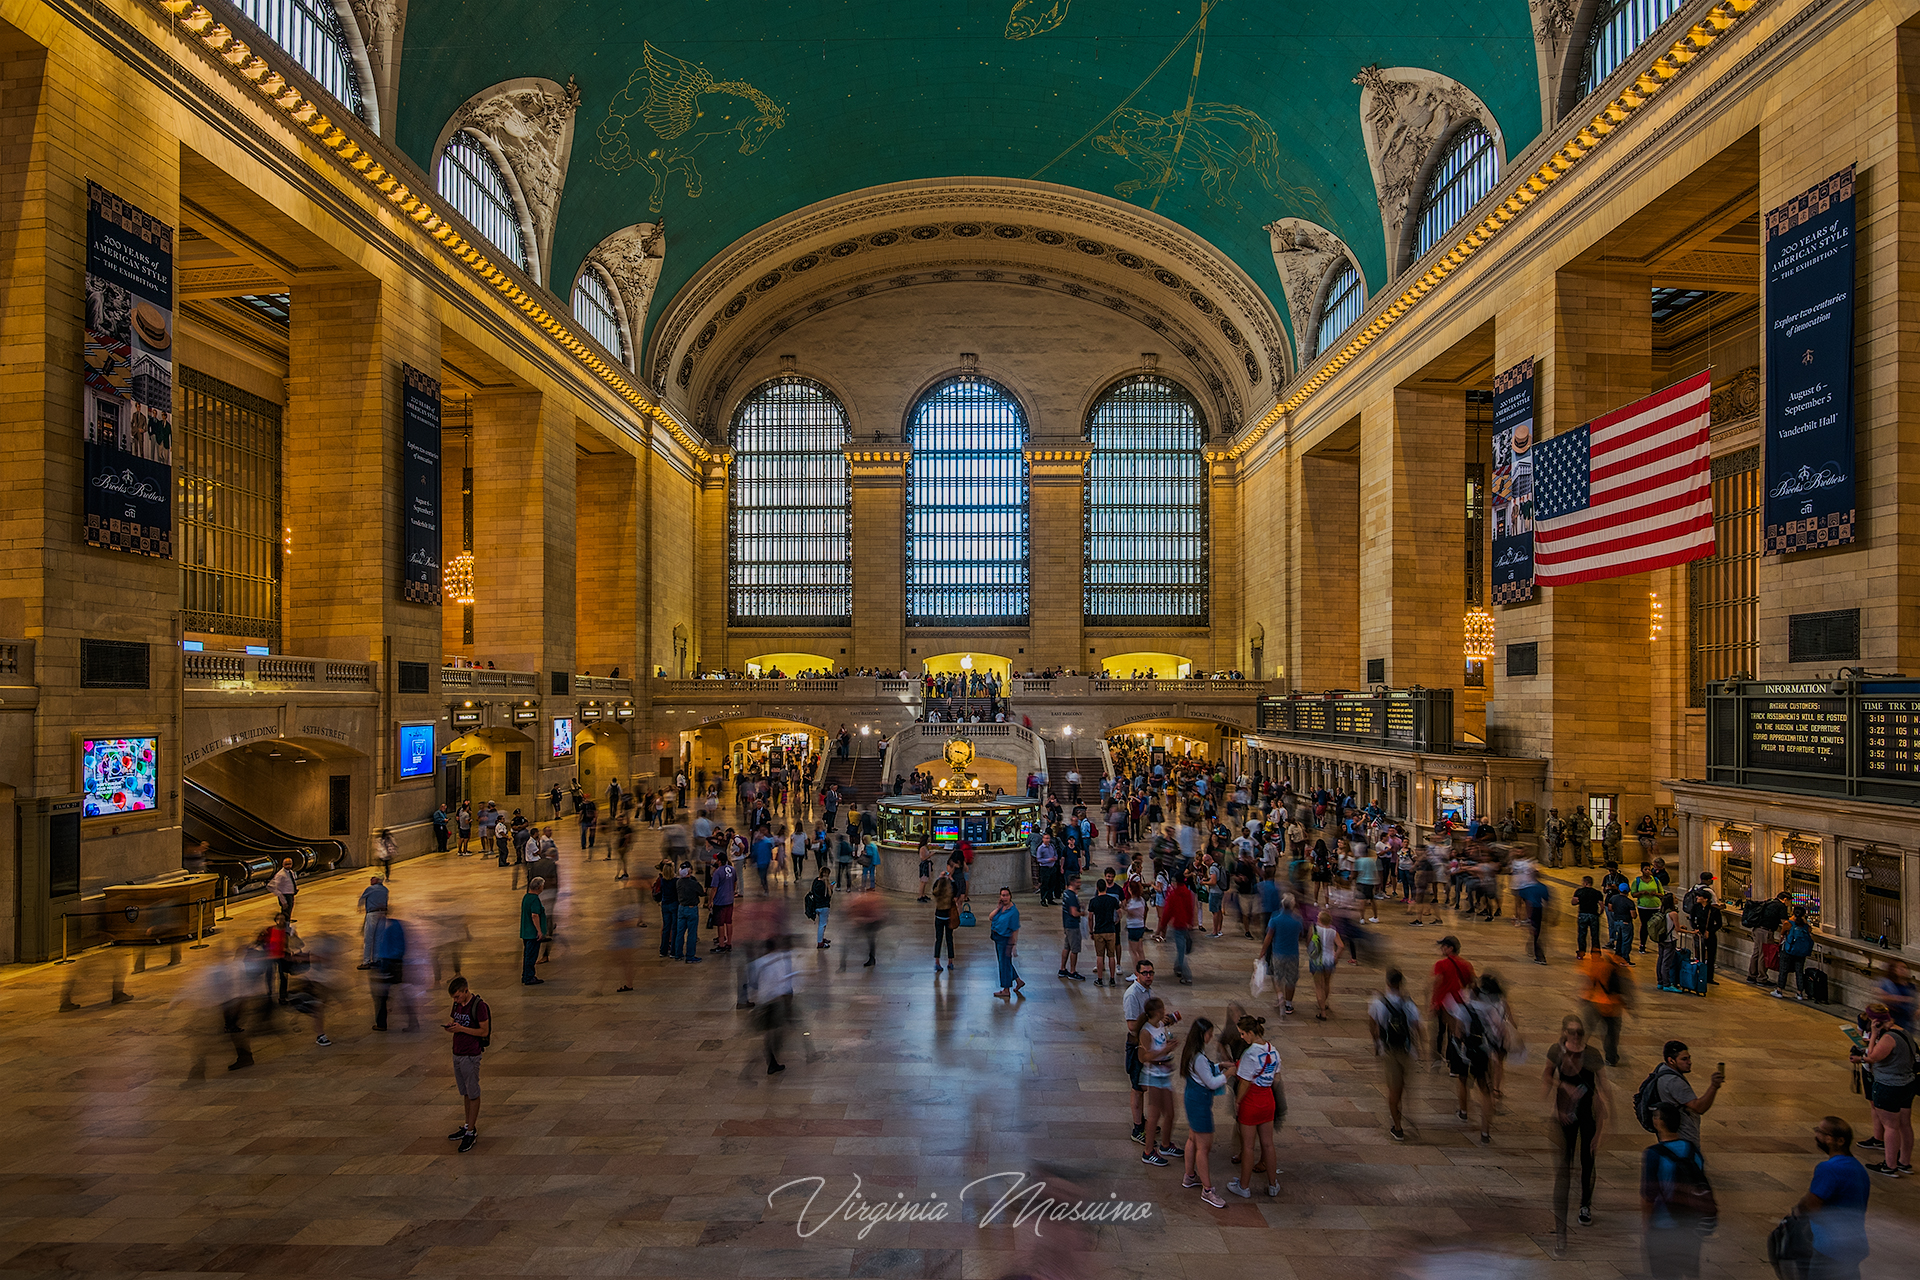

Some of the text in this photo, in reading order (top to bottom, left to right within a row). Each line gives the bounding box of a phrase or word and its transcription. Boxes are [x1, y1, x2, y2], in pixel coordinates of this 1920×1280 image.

[1780, 219, 1840, 257] 200 YEARS of
[103, 234, 160, 271] 200 YEARS of
[1771, 226, 1849, 273] AMERICAN STYLE
[93, 241, 168, 285] AMERICAN STYLE
[1780, 246, 1838, 280] THE EXHIBITION
[103, 258, 159, 292] THE EXHIBITION
[1773, 291, 1847, 330] Explore two centuries
[1785, 312, 1831, 338] of innovation
[1788, 386, 1815, 402] August
[1815, 382, 1822, 392] 6
[1784, 392, 1833, 416] September 5
[1778, 419, 1818, 439] Vanderbilt
[1769, 469, 1848, 499] Brooks Brothers
[127, 482, 167, 503] Brothers
[1765, 684, 1827, 694] INFORMATION
[1769, 702, 1821, 710] AMTRAK CUSTOMERS:
[1863, 702, 1884, 710] TIME
[1888, 702, 1907, 711] TRK
[764, 711, 800, 720] LEXINGTON
[1124, 713, 1159, 723] LEXINGTON
[1212, 714, 1241, 724] MACHINES
[1750, 712, 1766, 720] TRACK
[1767, 712, 1800, 720] ASSIGNMENTS
[1816, 713, 1825, 721] BE
[1826, 713, 1848, 722] POSTED
[1869, 714, 1885, 723] 3:19
[1895, 715, 1908, 723] 110
[302, 725, 346, 741] 45TH STREET
[1774, 723, 1794, 731] HUDSON
[1795, 724, 1809, 732] LINE
[1810, 724, 1841, 733] DEPARTURE
[1869, 726, 1885, 735] 3:22
[1895, 727, 1908, 736] 105
[183, 749, 201, 766] THE
[240, 726, 277, 742] BUILDING
[1752, 733, 1845, 745] BOARD APPROXIMATELY 20 MINUTES
[1869, 738, 1885, 747] 3:43
[1898, 739, 1908, 748] 28
[1786, 745, 1816, 754] DEPARTURE
[1817, 747, 1834, 755] TIME.
[1869, 750, 1885, 758] 3:52
[1895, 751, 1908, 760] 114
[1869, 762, 1885, 770] 3:55
[1895, 763, 1907, 772] 111
